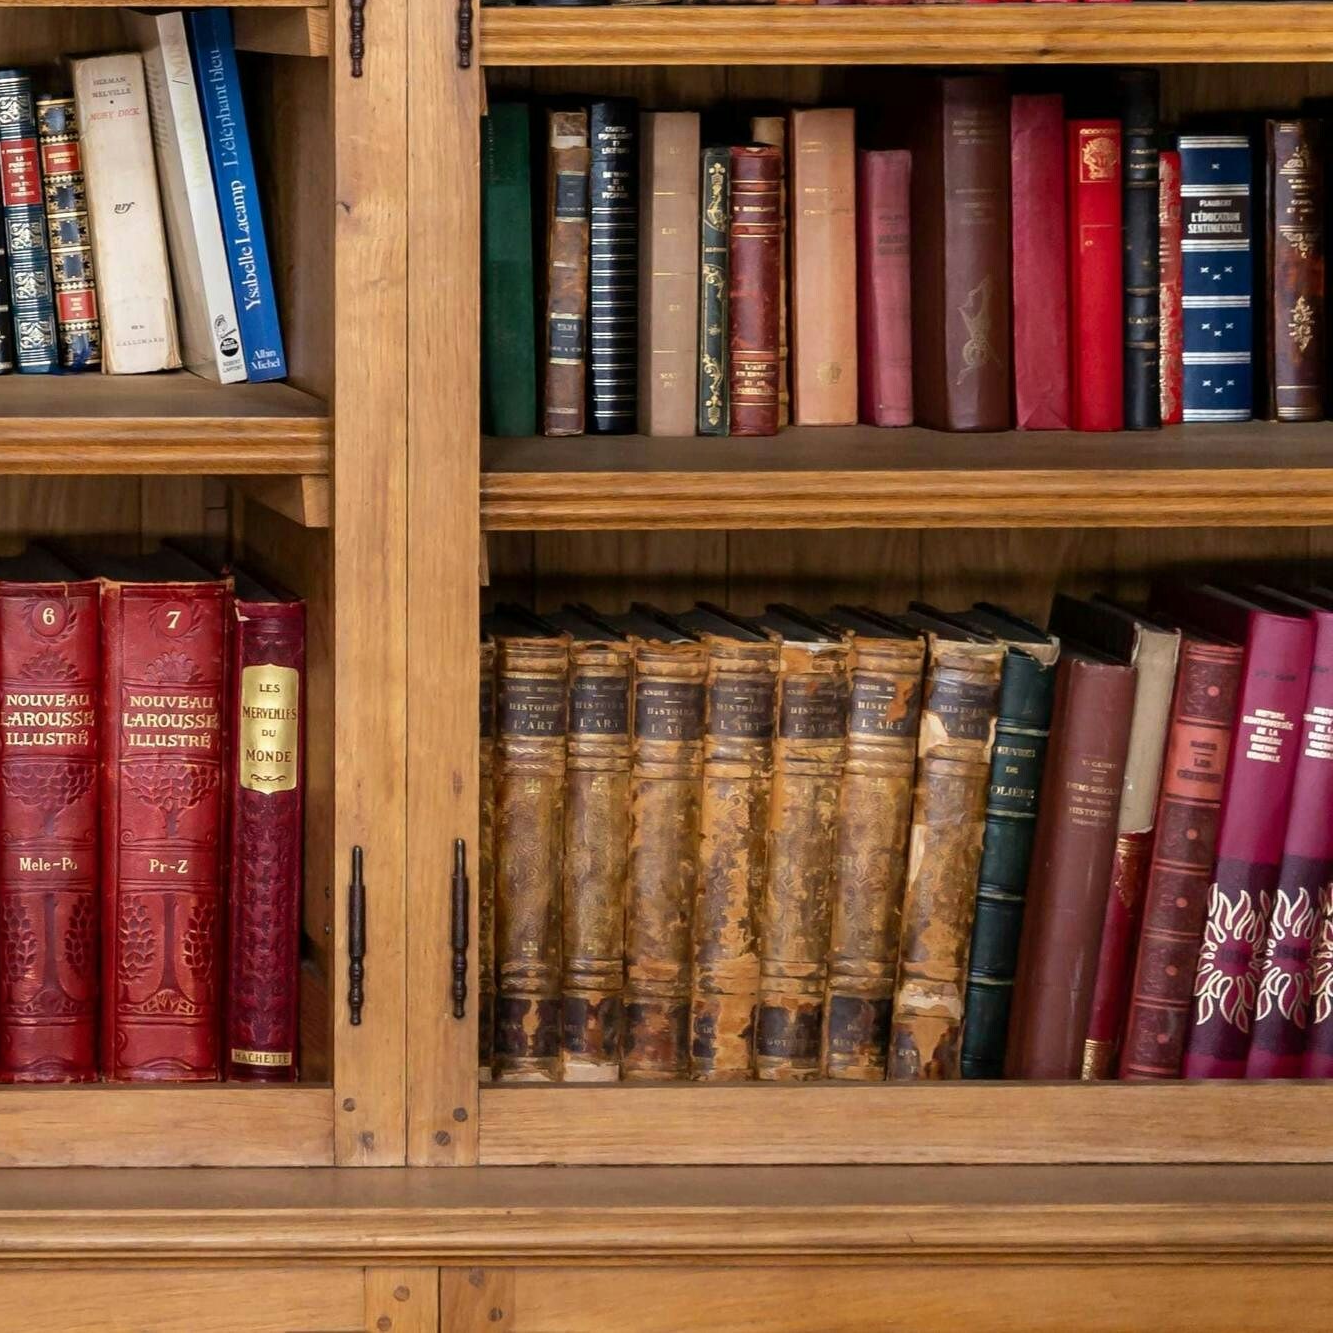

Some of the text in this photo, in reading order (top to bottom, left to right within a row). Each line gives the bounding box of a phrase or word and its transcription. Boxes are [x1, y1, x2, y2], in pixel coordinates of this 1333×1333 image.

[93, 77, 126, 86] HERMAN
[92, 88, 132, 97] MELVILLE
[118, 108, 140, 117] DICK
[209, 49, 238, 167] L'éléphant bleu
[114, 202, 135, 214] nrf
[231, 180, 261, 310] Ysabelle Lacamp
[254, 348, 276, 361] Albin
[252, 358, 281, 370] Michel
[43, 608, 55, 624] 6
[166, 612, 181, 628] 7
[259, 684, 281, 693] LES
[129, 695, 214, 709] NOUVEAU
[509, 703, 559, 711] HISTOIRE
[243, 706, 297, 720] MERVEILLES
[123, 713, 218, 728] LAROUSSE
[514, 721, 554, 730] L'ART
[862, 719, 903, 730] L'ART
[261, 729, 276, 737] DU
[129, 733, 212, 749] ILLUSTRÉ
[246, 749, 292, 763] MONDE
[20, 858, 78, 871] Mele-Po
[149, 859, 189, 873] Pr-Z
[235, 1050, 290, 1064] HACHETTE
